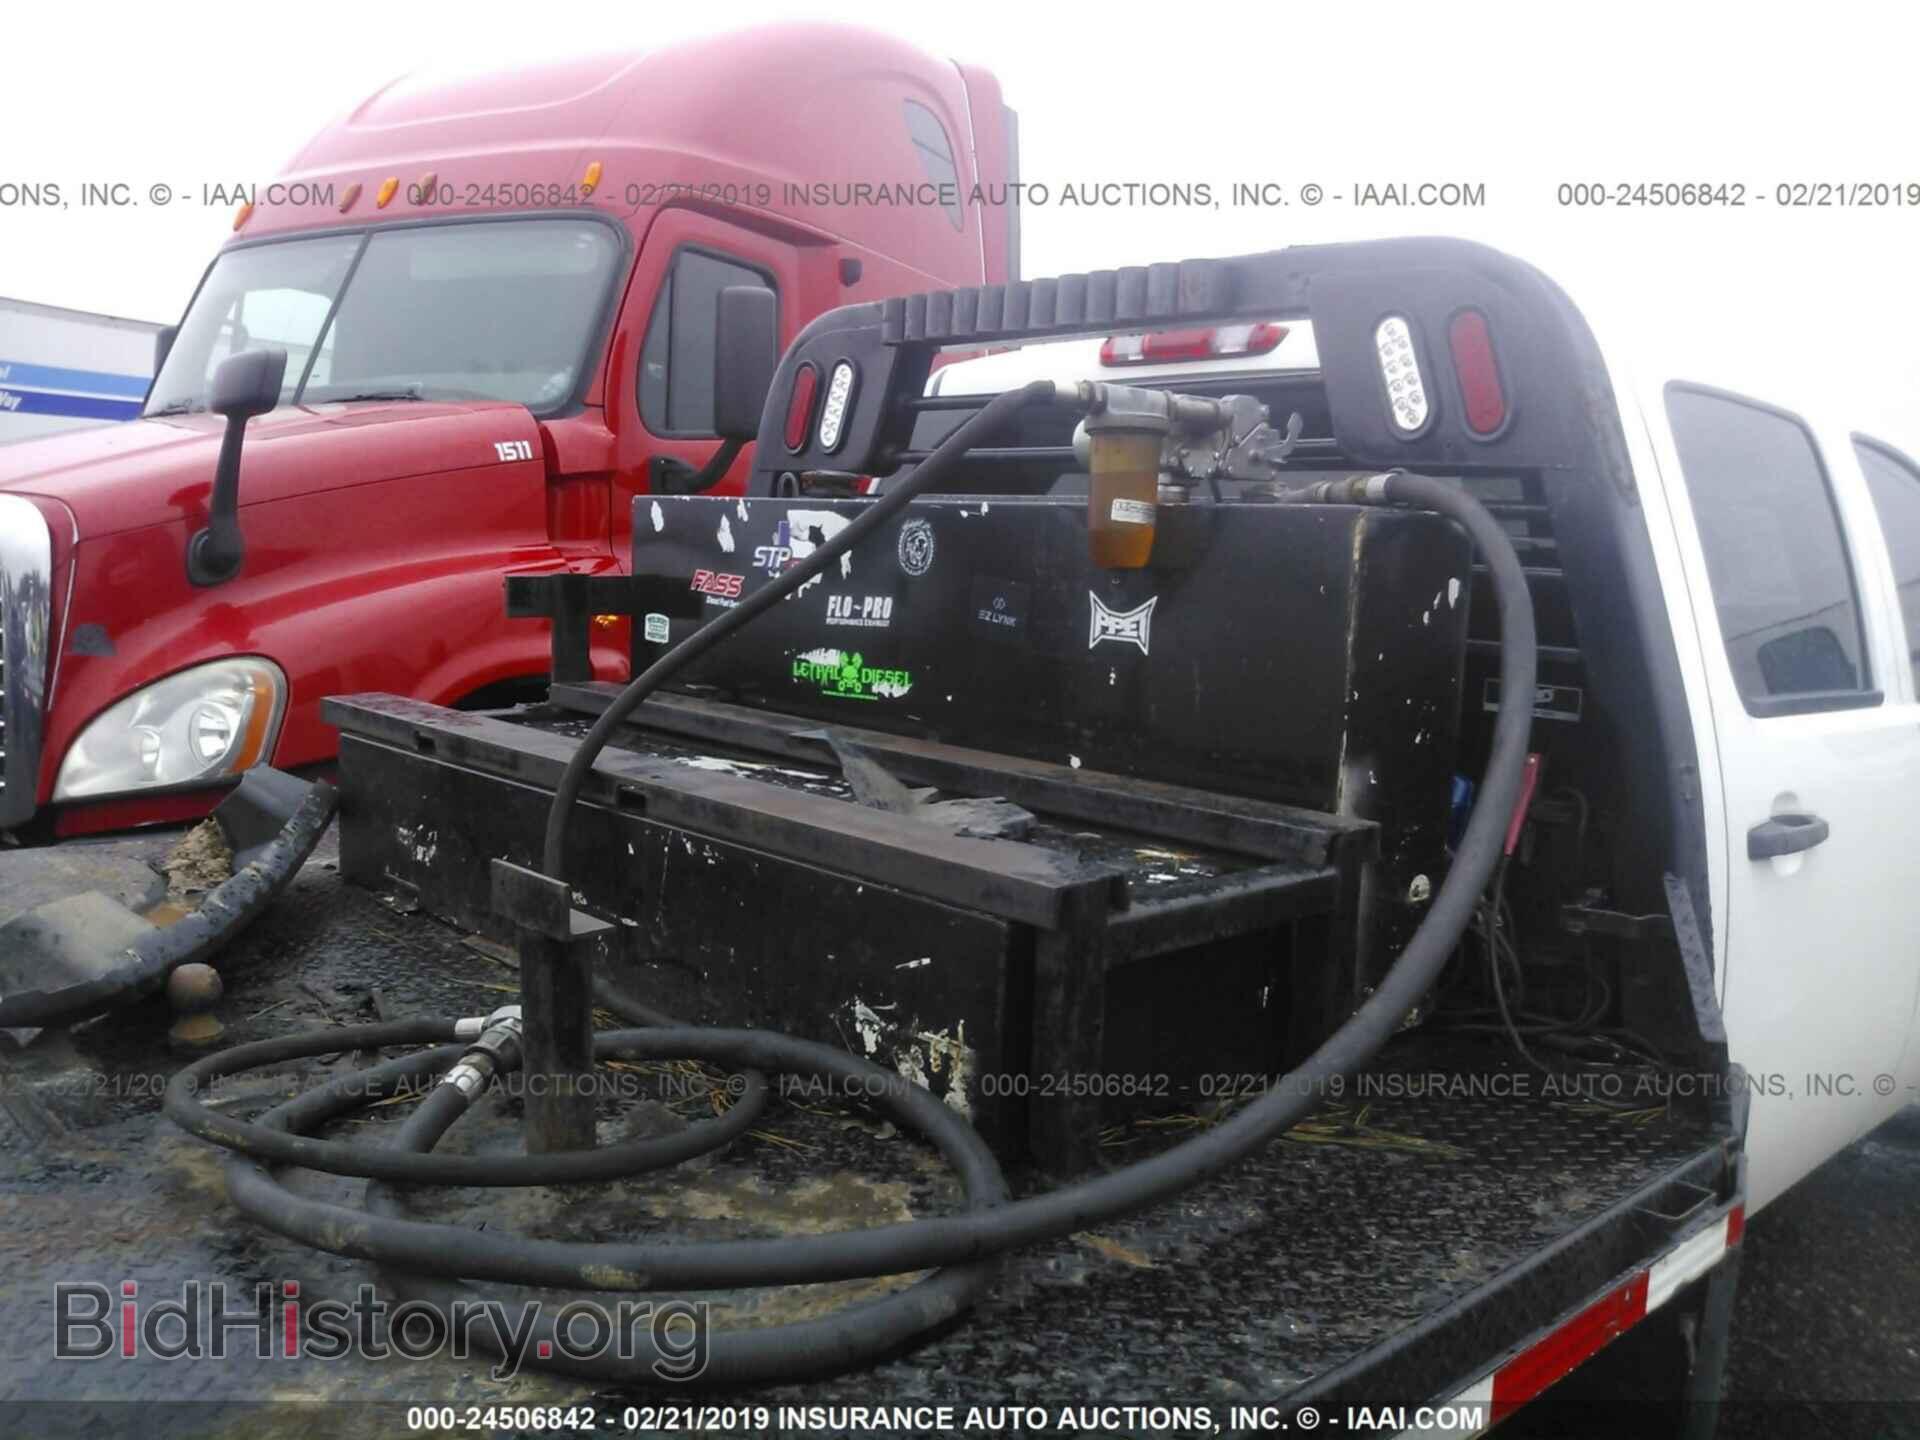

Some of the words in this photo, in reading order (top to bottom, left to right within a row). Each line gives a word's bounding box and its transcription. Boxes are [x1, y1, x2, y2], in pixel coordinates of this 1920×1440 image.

[494, 440, 533, 461] 1511
[752, 545, 792, 569] STP
[690, 569, 745, 598] FASS
[793, 660, 841, 687] LETHAL
[861, 667, 910, 689] DIESEL
